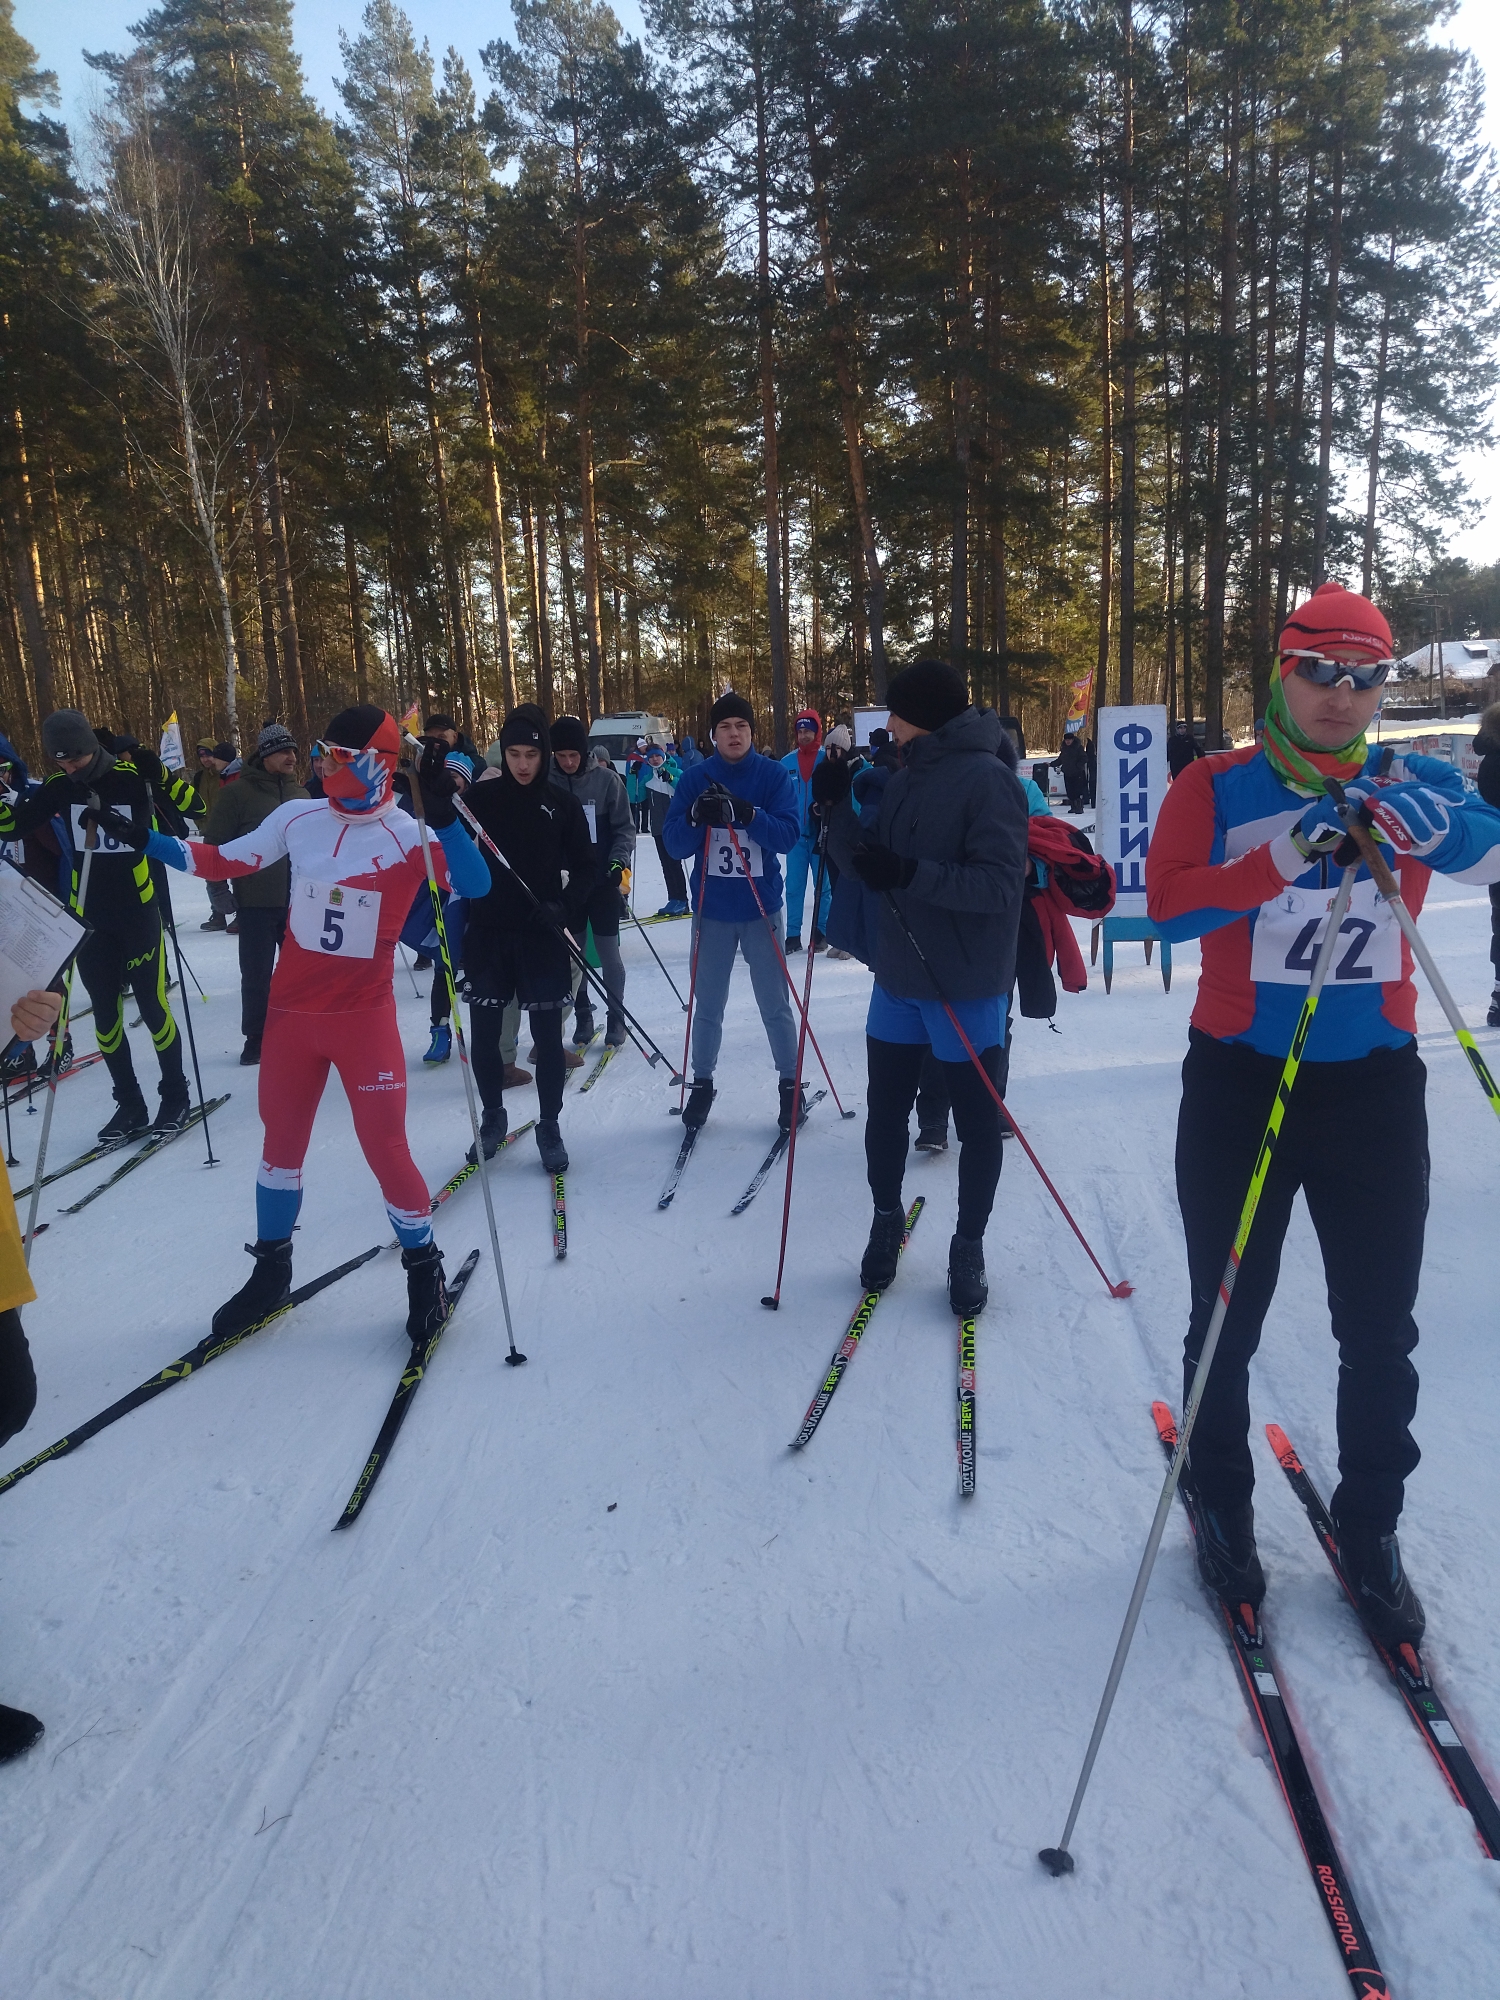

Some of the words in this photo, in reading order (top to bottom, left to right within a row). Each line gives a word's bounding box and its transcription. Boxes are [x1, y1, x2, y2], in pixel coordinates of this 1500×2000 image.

[1113, 723, 1153, 893] ФИНИШ
[1375, 807, 1393, 826] TIME
[1393, 824, 1408, 842] SKI
[718, 846, 752, 875] 33
[320, 908, 345, 951] 5
[1284, 917, 1376, 980] 42
[358, 1082, 406, 1092] NORDSKI
[202, 1303, 293, 1365] FISCHER
[840, 1338, 855, 1355] 190
[0, 1438, 69, 1488] FISCHE
[345, 1453, 380, 1515] FISCHER
[1316, 1864, 1360, 1955] ROSSIGNOL
